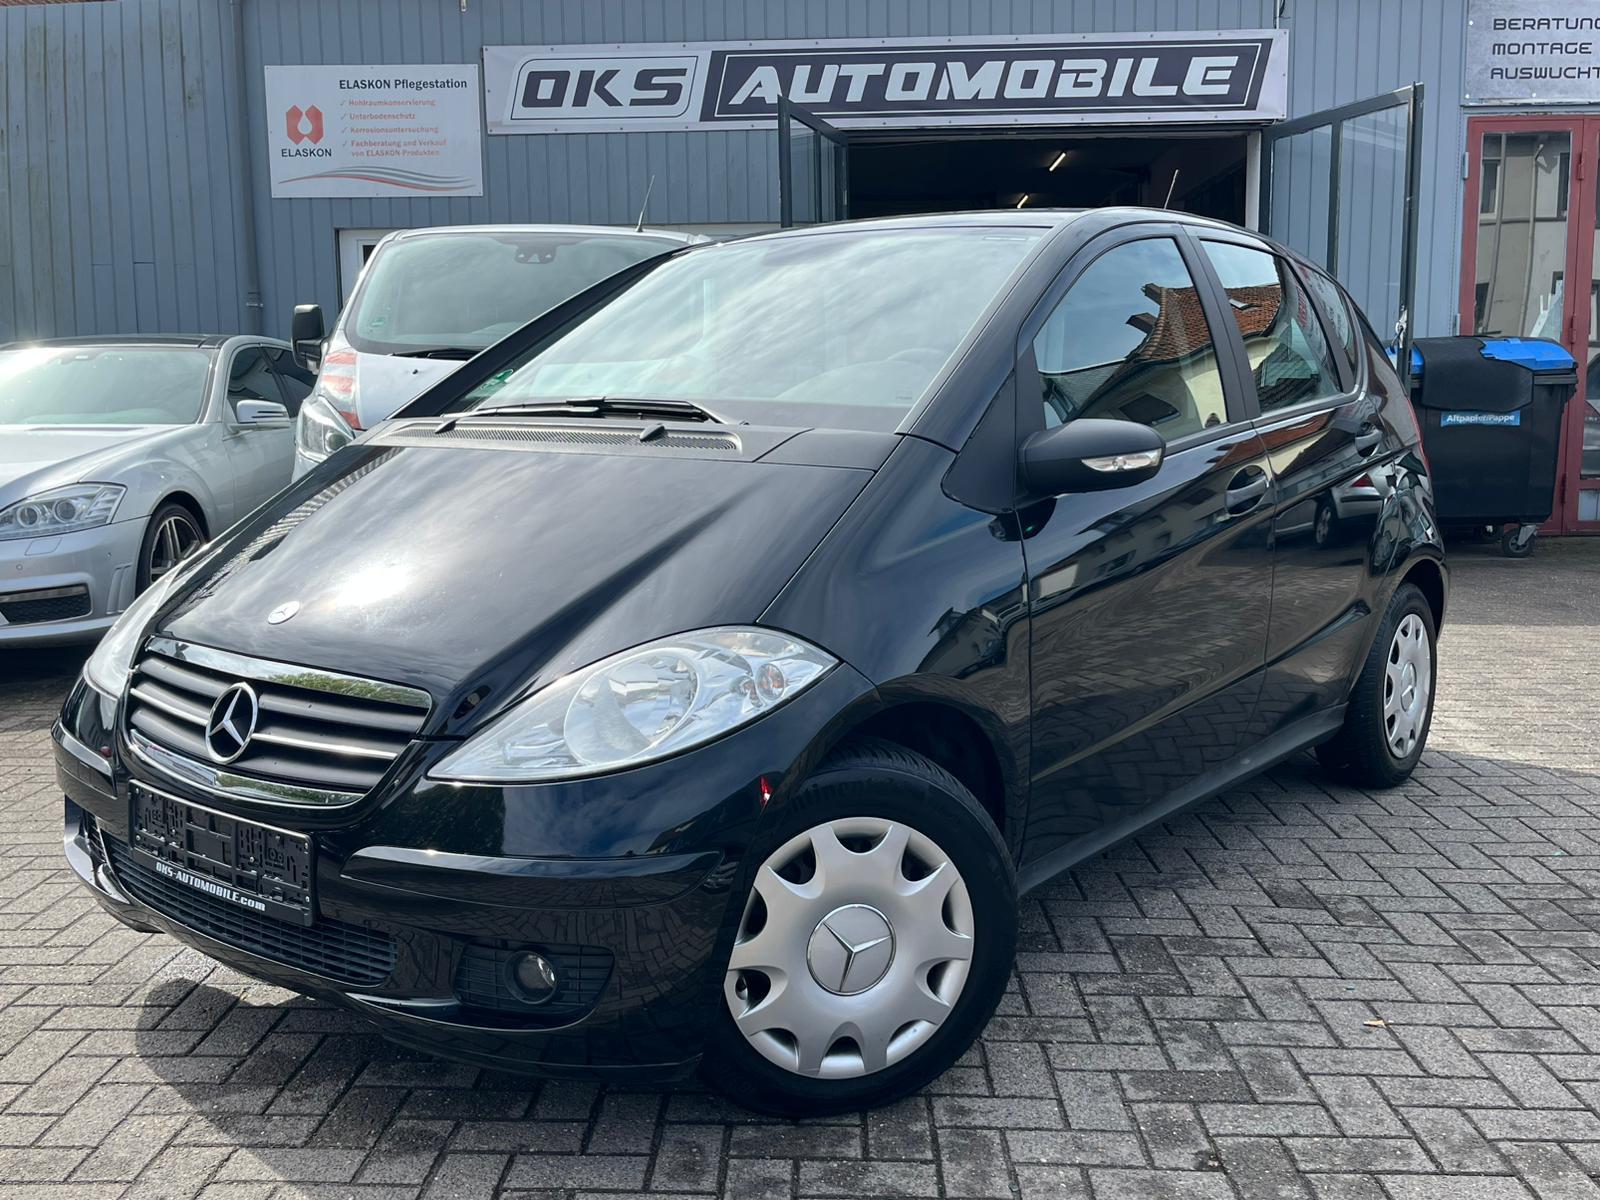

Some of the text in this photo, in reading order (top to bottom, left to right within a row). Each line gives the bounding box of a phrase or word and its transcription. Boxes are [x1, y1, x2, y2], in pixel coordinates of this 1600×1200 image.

[1492, 42, 1593, 55] MONTAGE
[1490, 67, 1600, 80] AUSWUCHT
[339, 78, 468, 91] ELASKON Pflegestation
[521, 55, 1240, 108] OKS AUTOMOBILE
[348, 99, 436, 108] Hohlraumkonservierung
[349, 112, 416, 120] Unterbodenschutz
[350, 126, 439, 135] Korrosionsuntersuchung
[351, 140, 402, 148] Fachberatung
[417, 139, 448, 147] Verkauf
[281, 148, 332, 158] ELASKON
[155, 861, 266, 912] OKS-AUTOMOBILE.com
